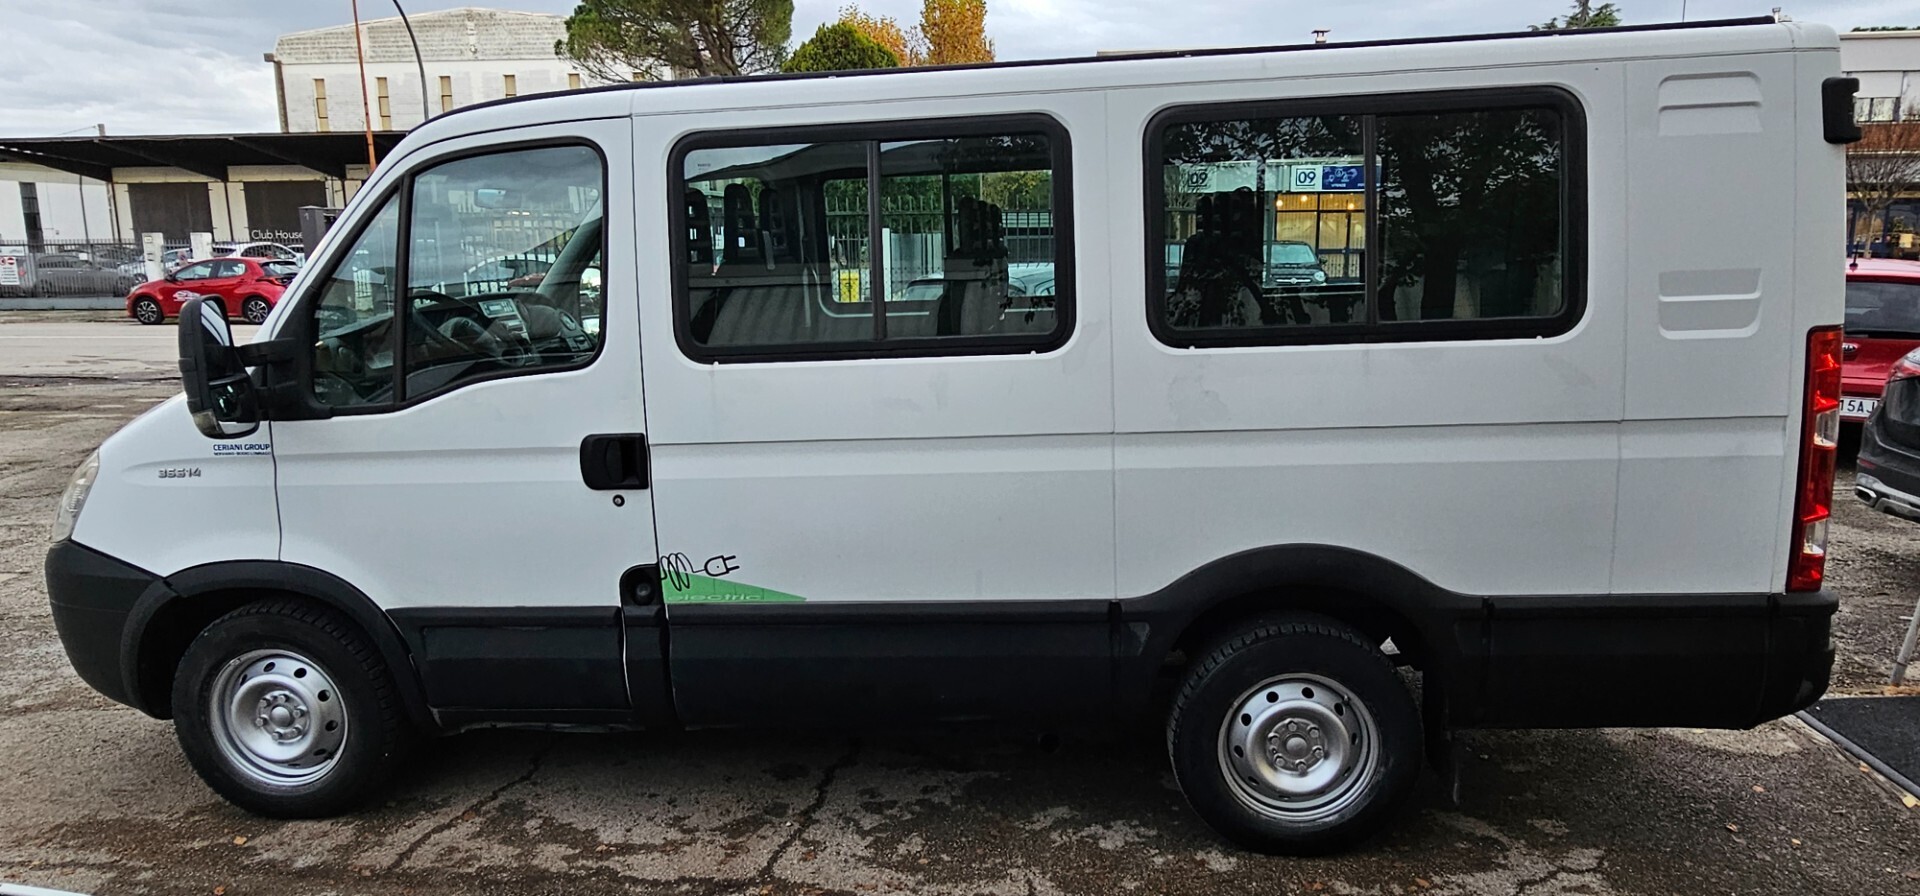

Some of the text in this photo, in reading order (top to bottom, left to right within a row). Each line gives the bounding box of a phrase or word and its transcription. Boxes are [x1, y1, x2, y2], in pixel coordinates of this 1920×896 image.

[1190, 171, 1208, 184] 09
[1298, 171, 1316, 184] 09
[251, 229, 303, 239] Club House
[244, 443, 270, 451] GROUP
